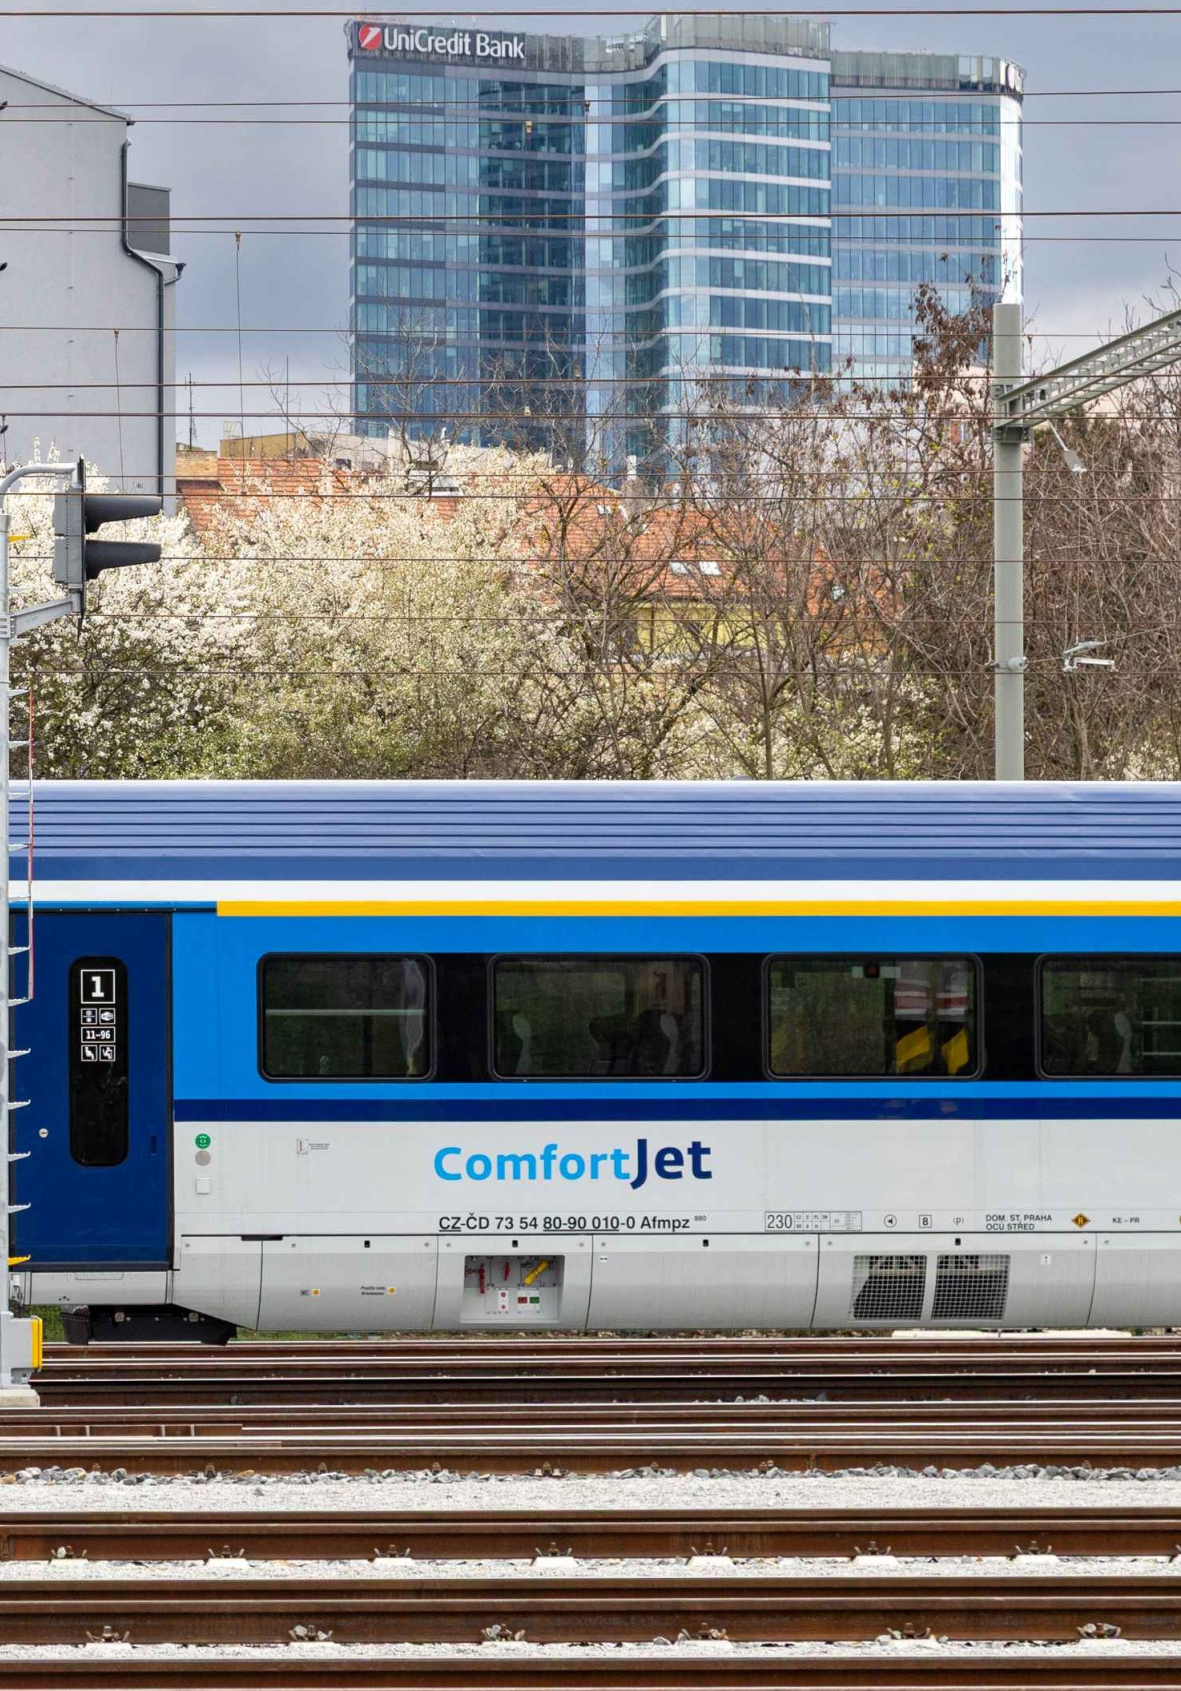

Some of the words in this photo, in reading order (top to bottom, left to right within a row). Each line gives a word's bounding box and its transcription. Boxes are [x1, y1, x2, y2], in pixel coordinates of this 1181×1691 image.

[384, 27, 471, 56] UniCredit
[476, 33, 525, 59] Bank
[91, 976, 104, 998] 1
[86, 1030, 111, 1040] 11-96
[434, 1138, 713, 1190] ComfortJet
[439, 1211, 489, 1231] CZ-ČD
[495, 1216, 514, 1230] 73
[519, 1216, 538, 1230] 54
[543, 1216, 587, 1230] 80-90
[592, 1216, 636, 1230] 010-0
[640, 1216, 691, 1233] Afmpz
[767, 1214, 793, 1229] 230
[922, 1217, 929, 1226] 8
[1023, 1214, 1053, 1222] PRAHA
[986, 1223, 1005, 1231] OCU
